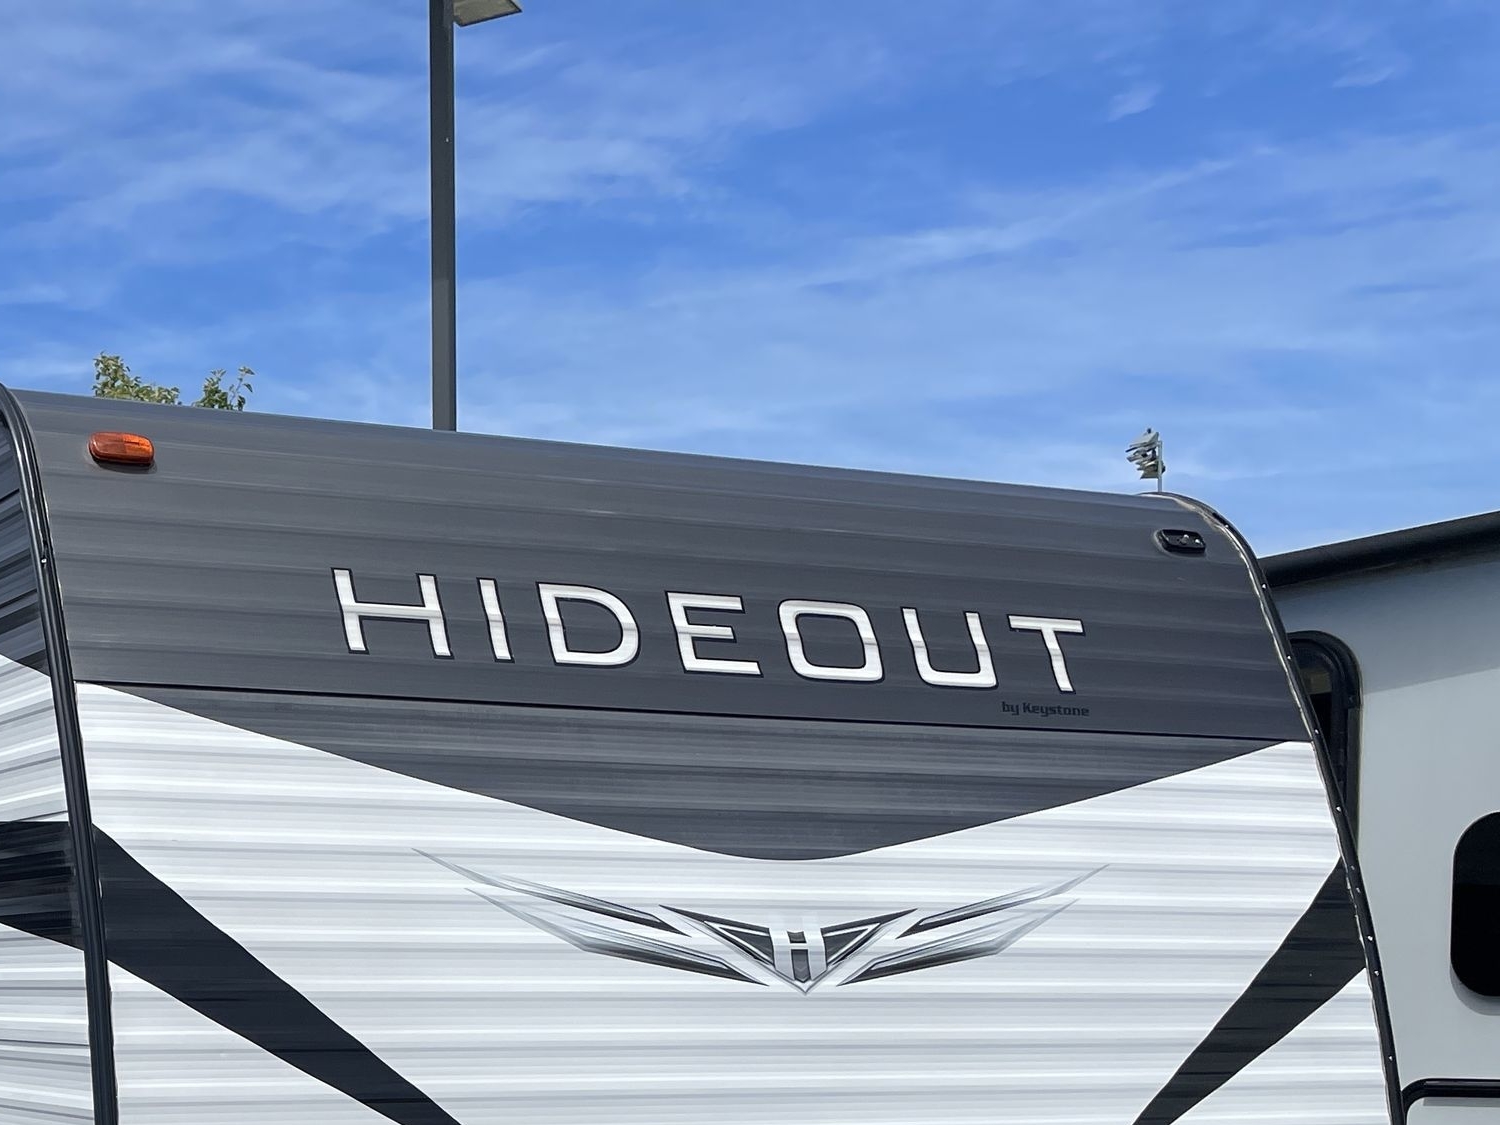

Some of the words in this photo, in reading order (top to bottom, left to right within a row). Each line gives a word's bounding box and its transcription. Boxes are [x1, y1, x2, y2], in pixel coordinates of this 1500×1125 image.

[331, 567, 1086, 695] HIDEOUT
[1002, 701, 1020, 716] by
[1022, 702, 1090, 717] Keystone
